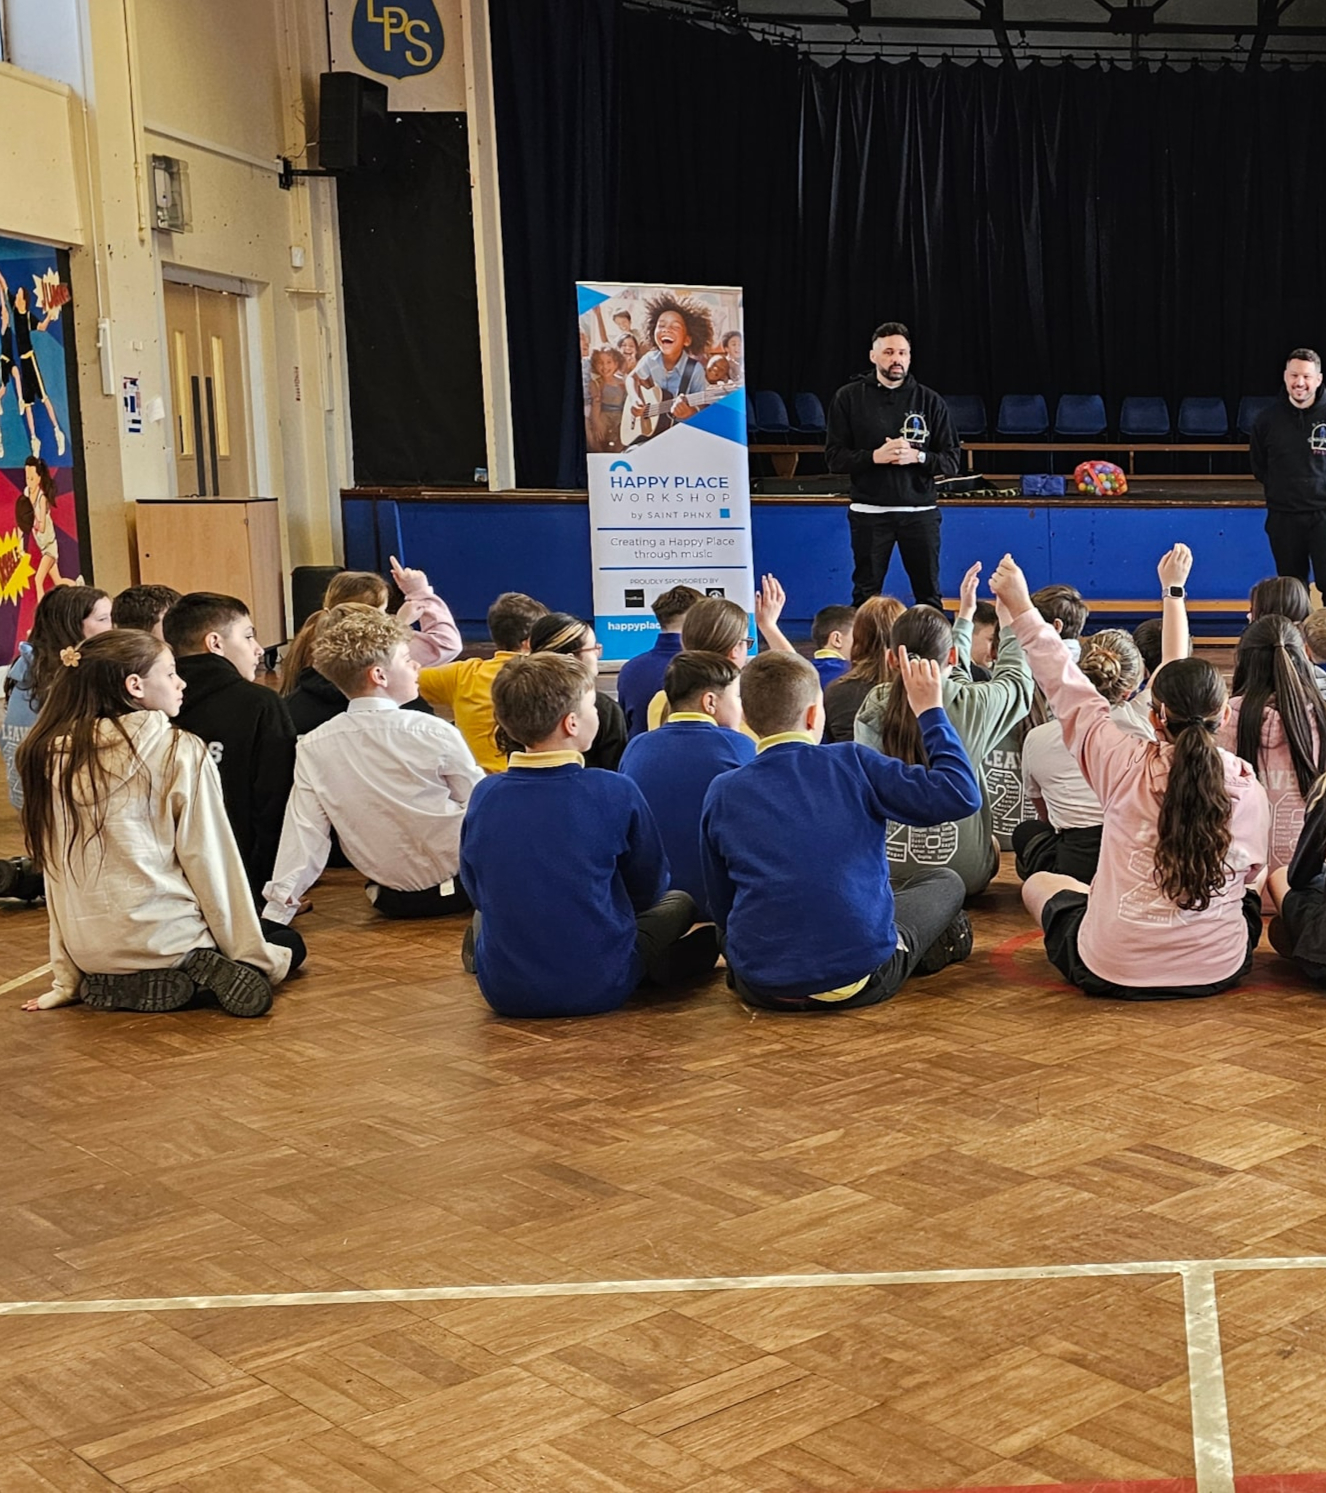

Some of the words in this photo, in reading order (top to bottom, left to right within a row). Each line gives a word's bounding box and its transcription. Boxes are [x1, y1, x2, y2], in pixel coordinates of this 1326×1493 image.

[367, 0, 433, 67] LPS
[610, 476, 669, 489] HAPPY
[674, 477, 729, 489] PLACE
[610, 493, 730, 503] WORKSHOP
[631, 512, 643, 521] by
[647, 511, 679, 519] SAINT
[683, 511, 713, 519] PHNX
[610, 537, 657, 551] Creating
[669, 537, 704, 551] Happy
[706, 537, 736, 547] Place
[634, 550, 678, 560] through
[681, 550, 713, 559] music
[607, 621, 662, 632] happyplac
